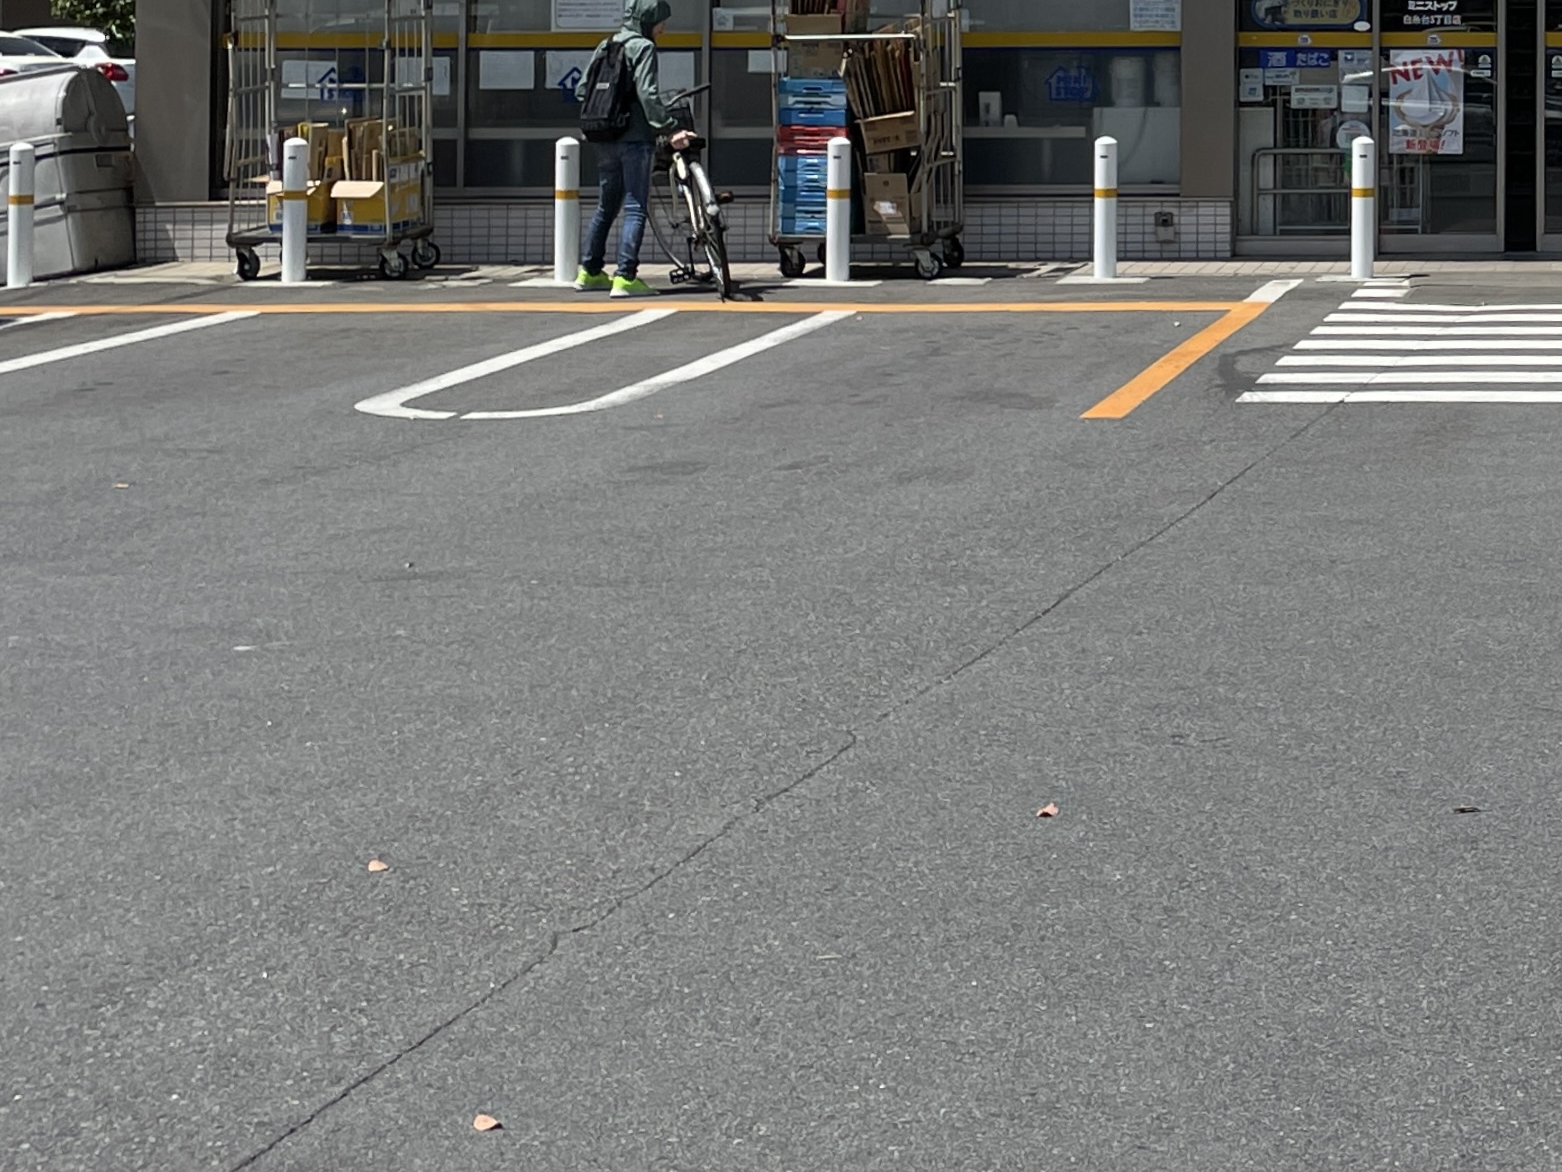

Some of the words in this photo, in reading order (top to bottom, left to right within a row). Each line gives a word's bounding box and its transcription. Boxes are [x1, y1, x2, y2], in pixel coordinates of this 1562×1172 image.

[1407, 0, 1458, 12] ミニストップ
[1267, 51, 1287, 67] 酒
[1296, 52, 1330, 67] たばこ
